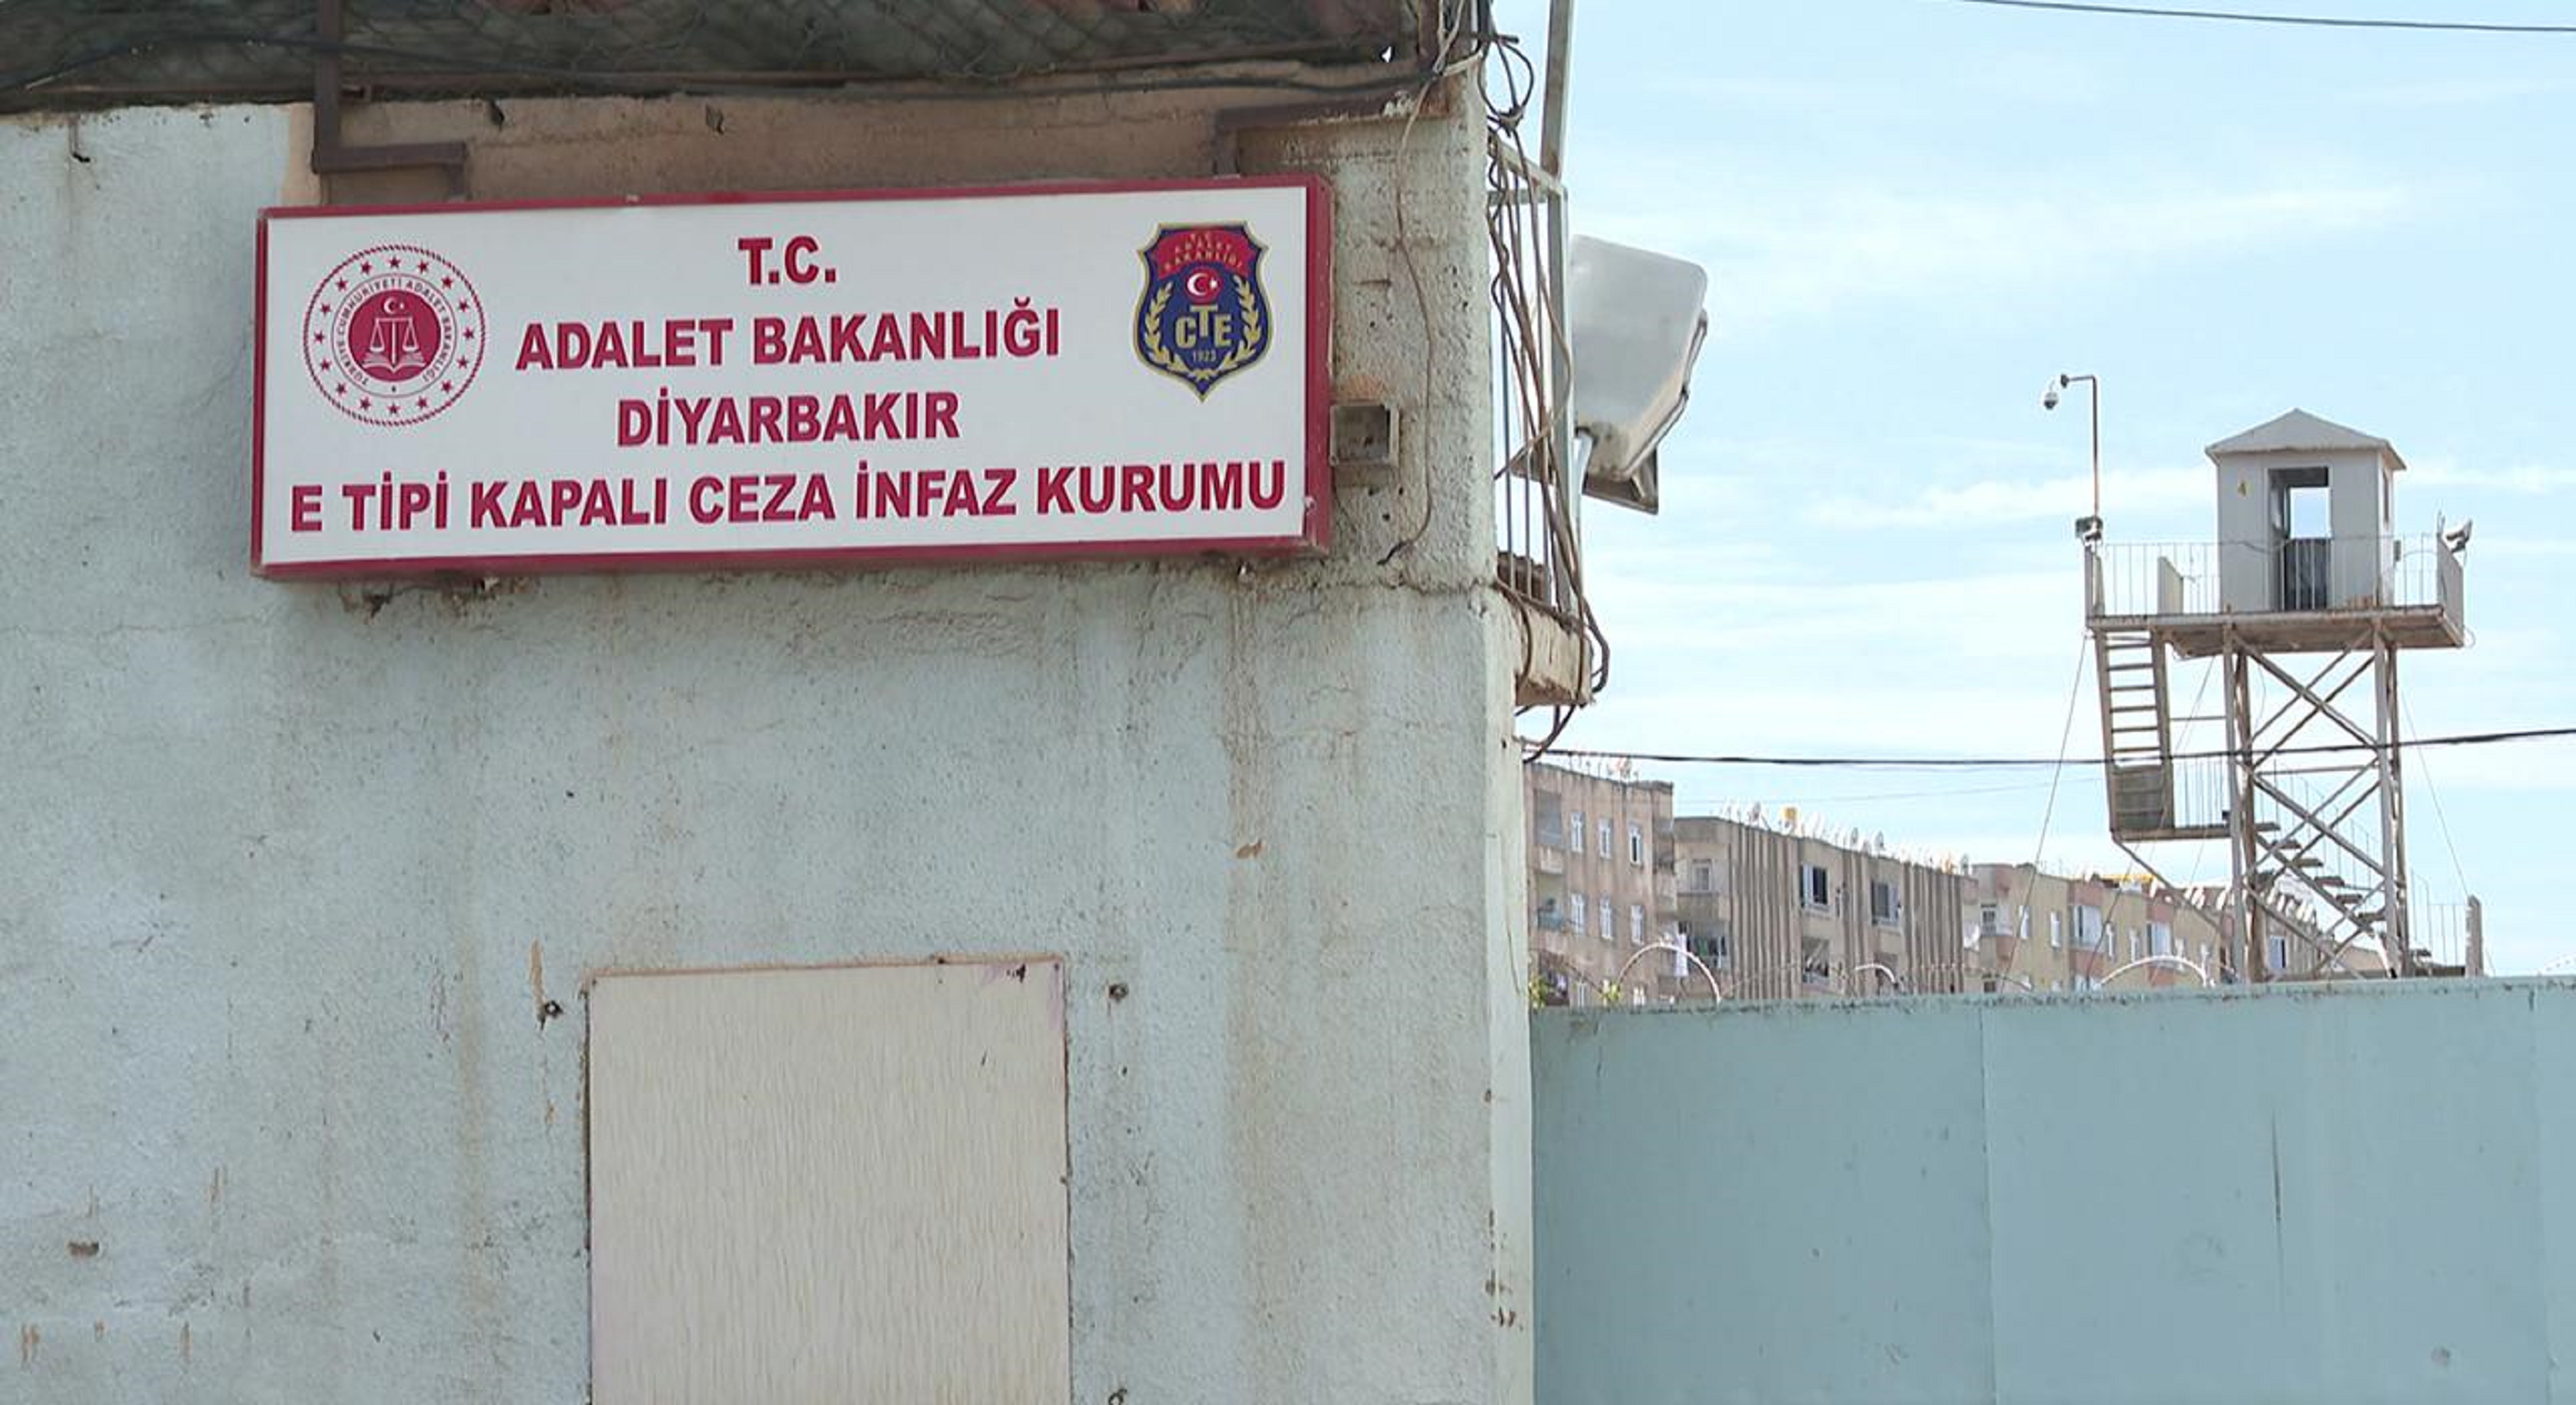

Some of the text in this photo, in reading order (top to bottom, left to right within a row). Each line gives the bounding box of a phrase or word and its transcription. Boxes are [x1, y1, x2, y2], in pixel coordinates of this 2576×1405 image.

[737, 235, 837, 286] T.C.
[405, 280, 445, 313] ADALET
[515, 296, 1059, 371] ADALET BAKANLIĞI
[1175, 305, 1233, 348] CTE
[1191, 349, 1217, 363] 1923
[617, 386, 960, 448] DİYARBAKIR
[291, 459, 1285, 532] E TİPİ KAPALI CEZA İNFAZ KURUMU
